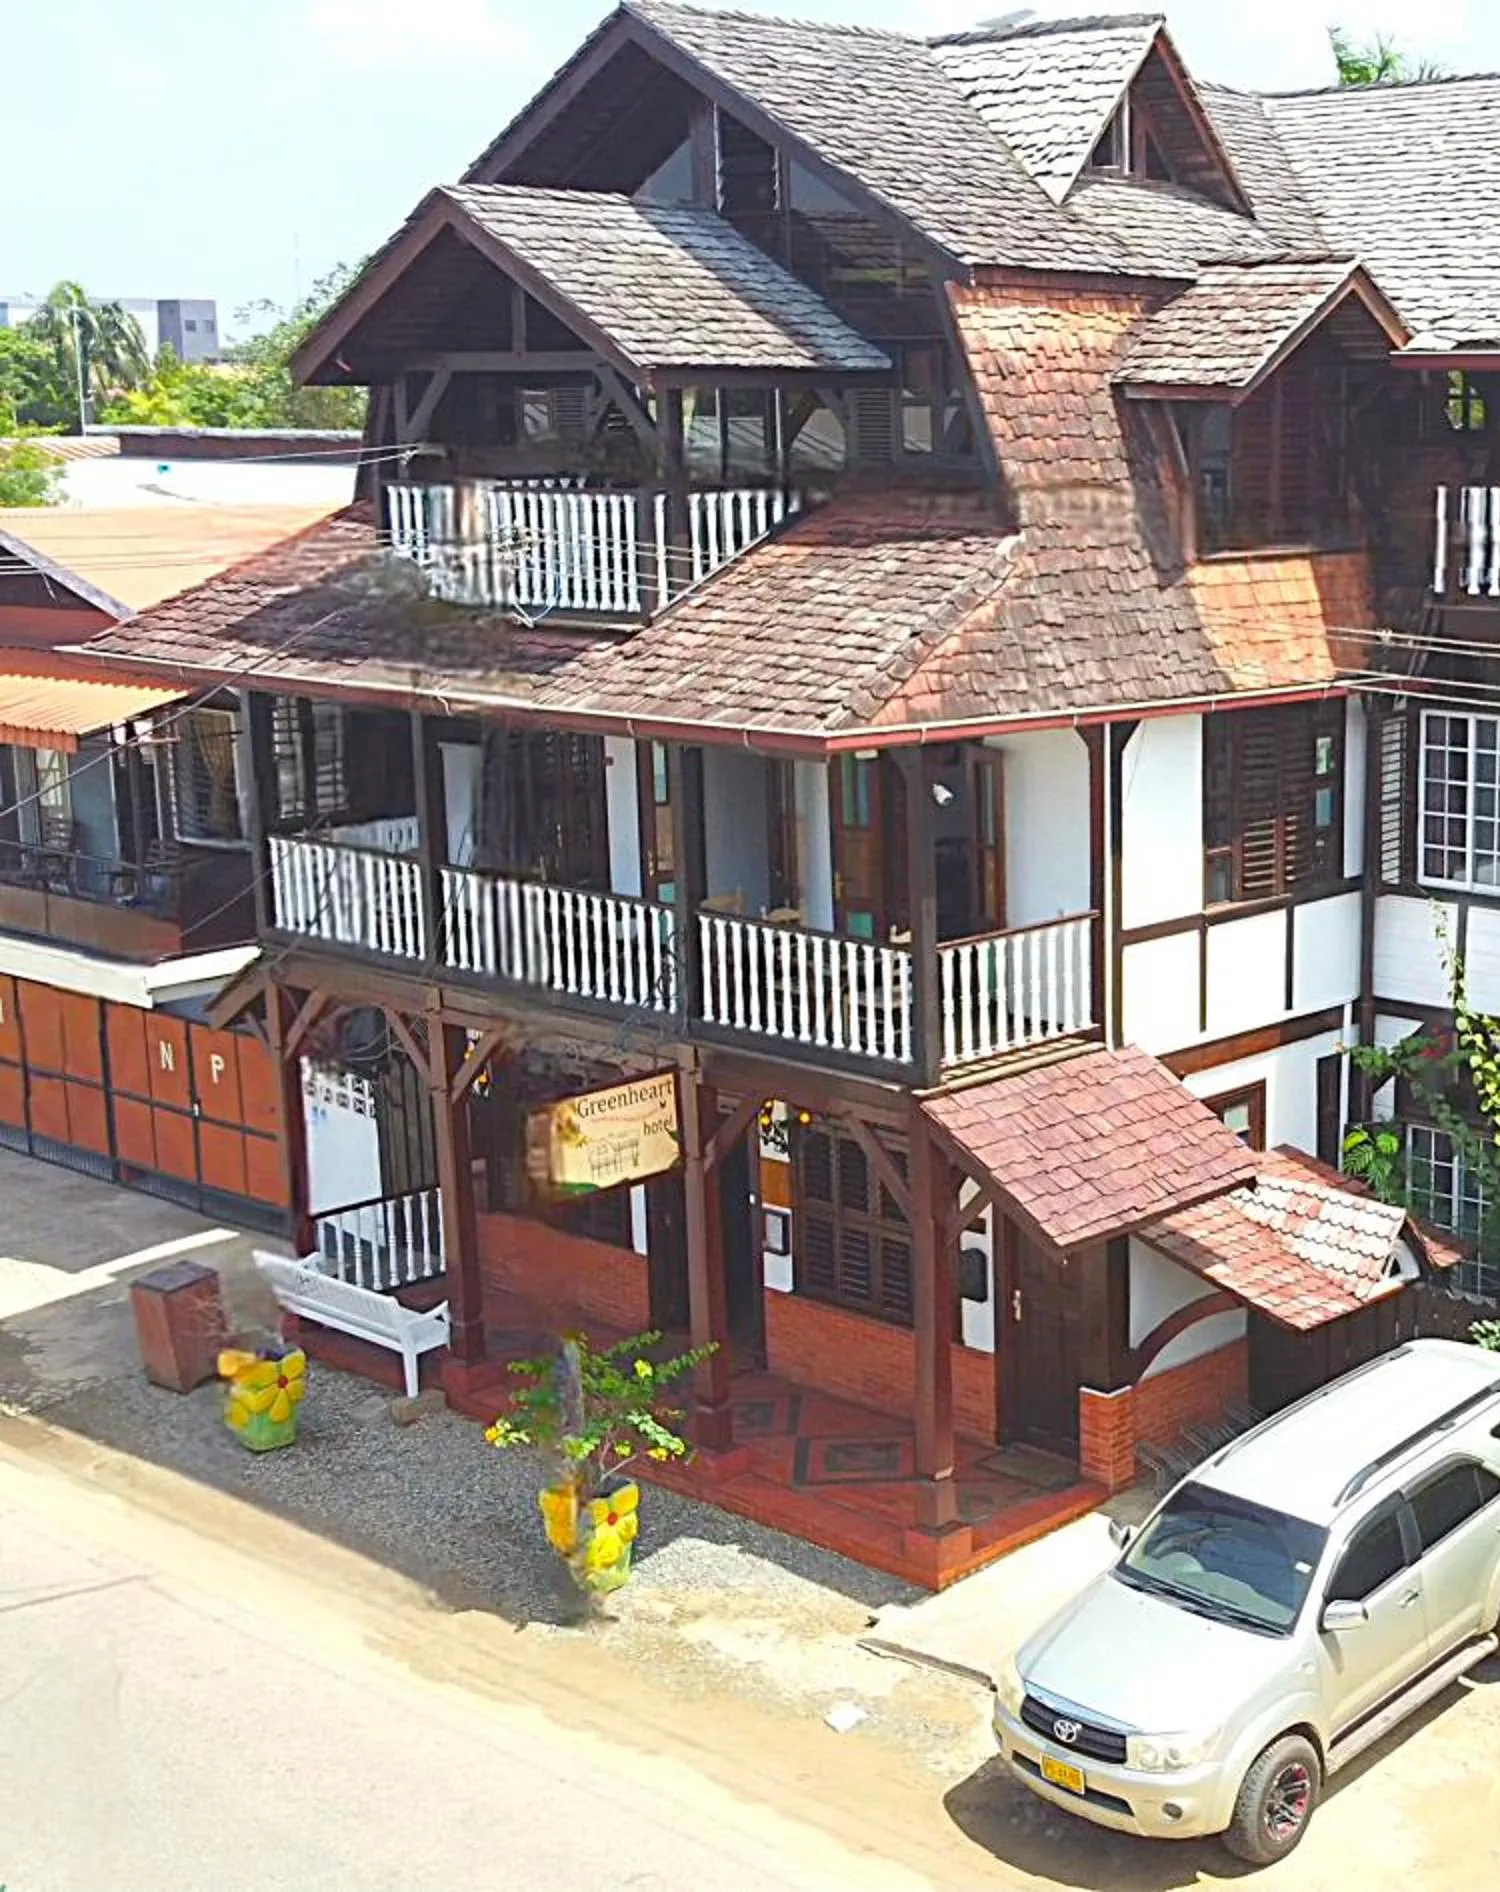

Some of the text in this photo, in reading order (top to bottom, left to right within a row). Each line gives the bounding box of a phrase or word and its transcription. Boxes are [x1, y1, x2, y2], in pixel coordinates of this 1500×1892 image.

[159, 1040, 225, 1084] N P
[577, 1079, 673, 1119] Greenheart
[643, 1114, 673, 1136] hotel
